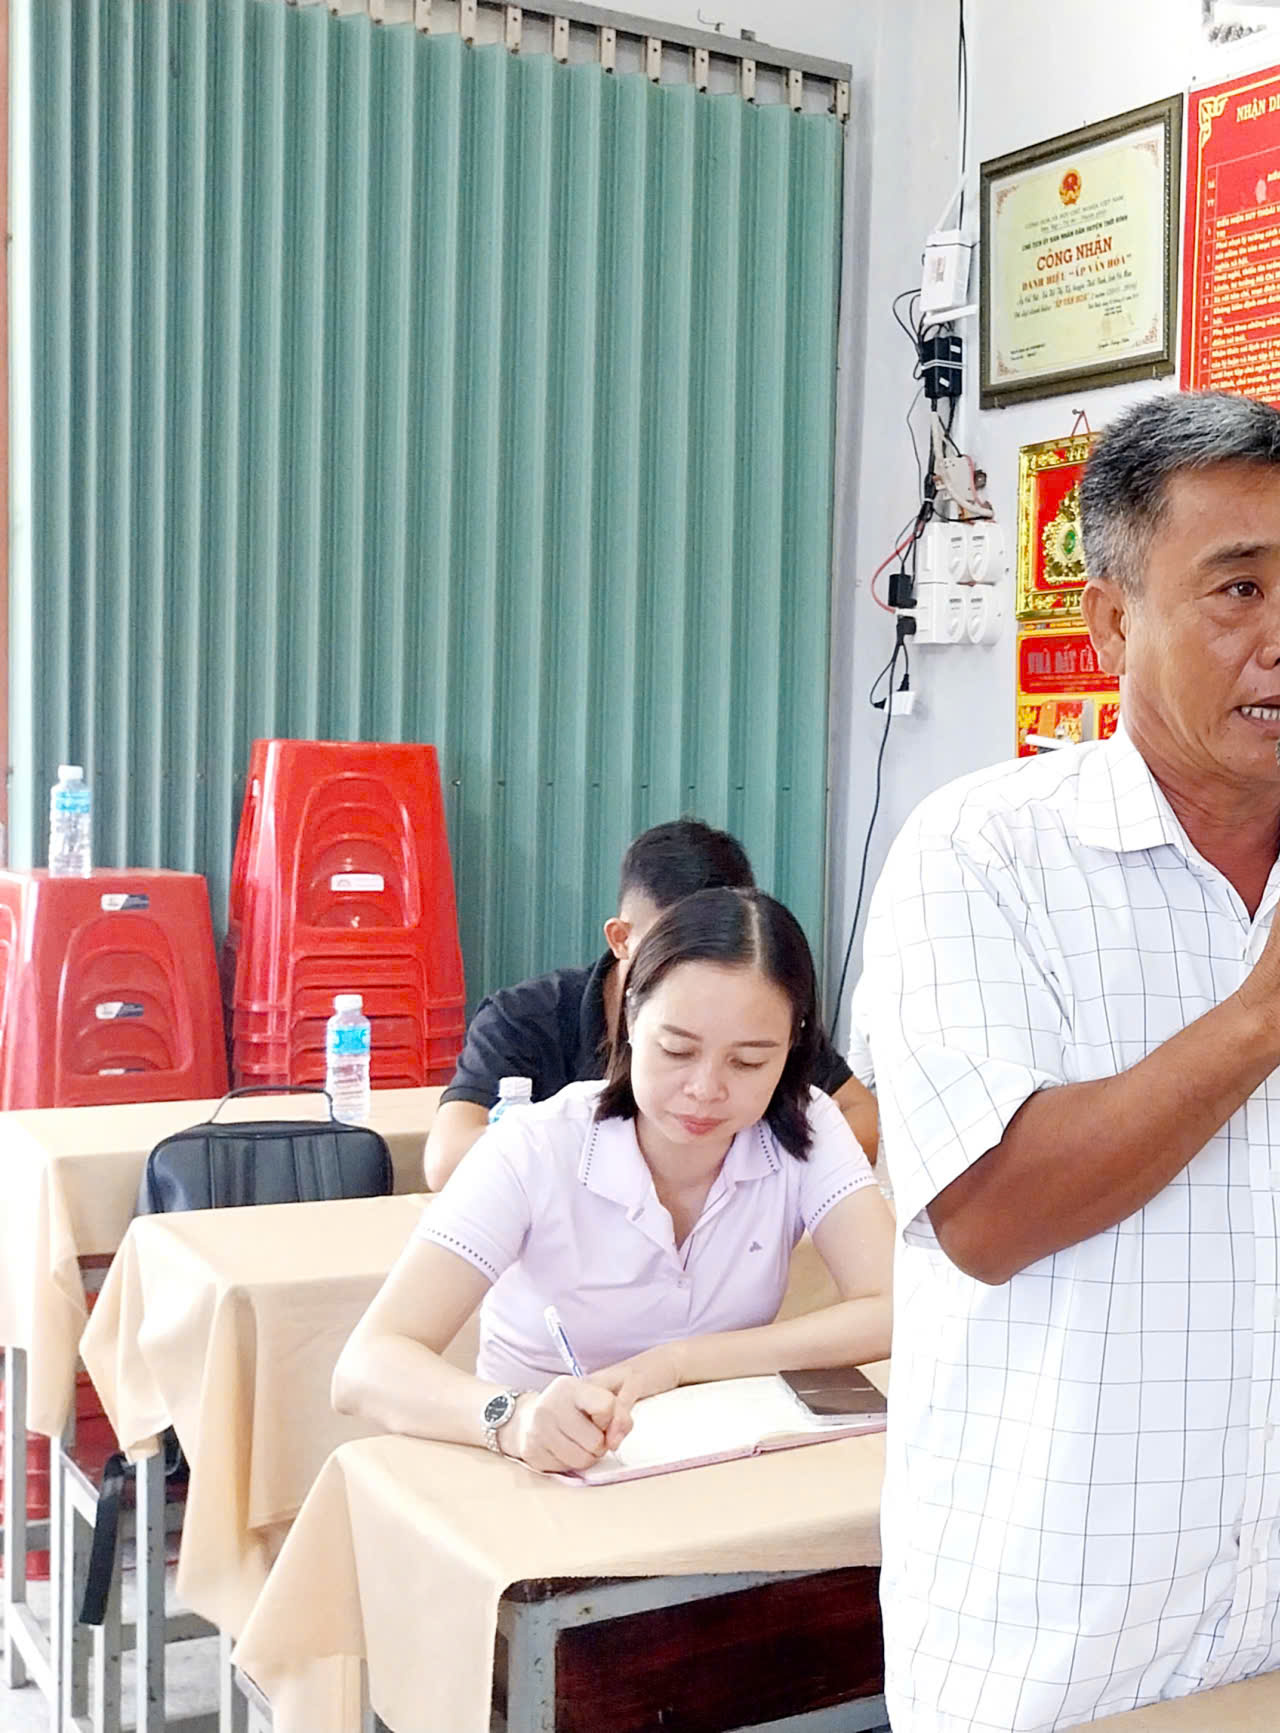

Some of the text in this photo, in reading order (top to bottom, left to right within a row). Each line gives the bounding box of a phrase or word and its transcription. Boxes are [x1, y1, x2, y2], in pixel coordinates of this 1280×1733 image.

[1235, 97, 1267, 123] NHẬN
[1036, 234, 1112, 271] CÔNG NHẬN
